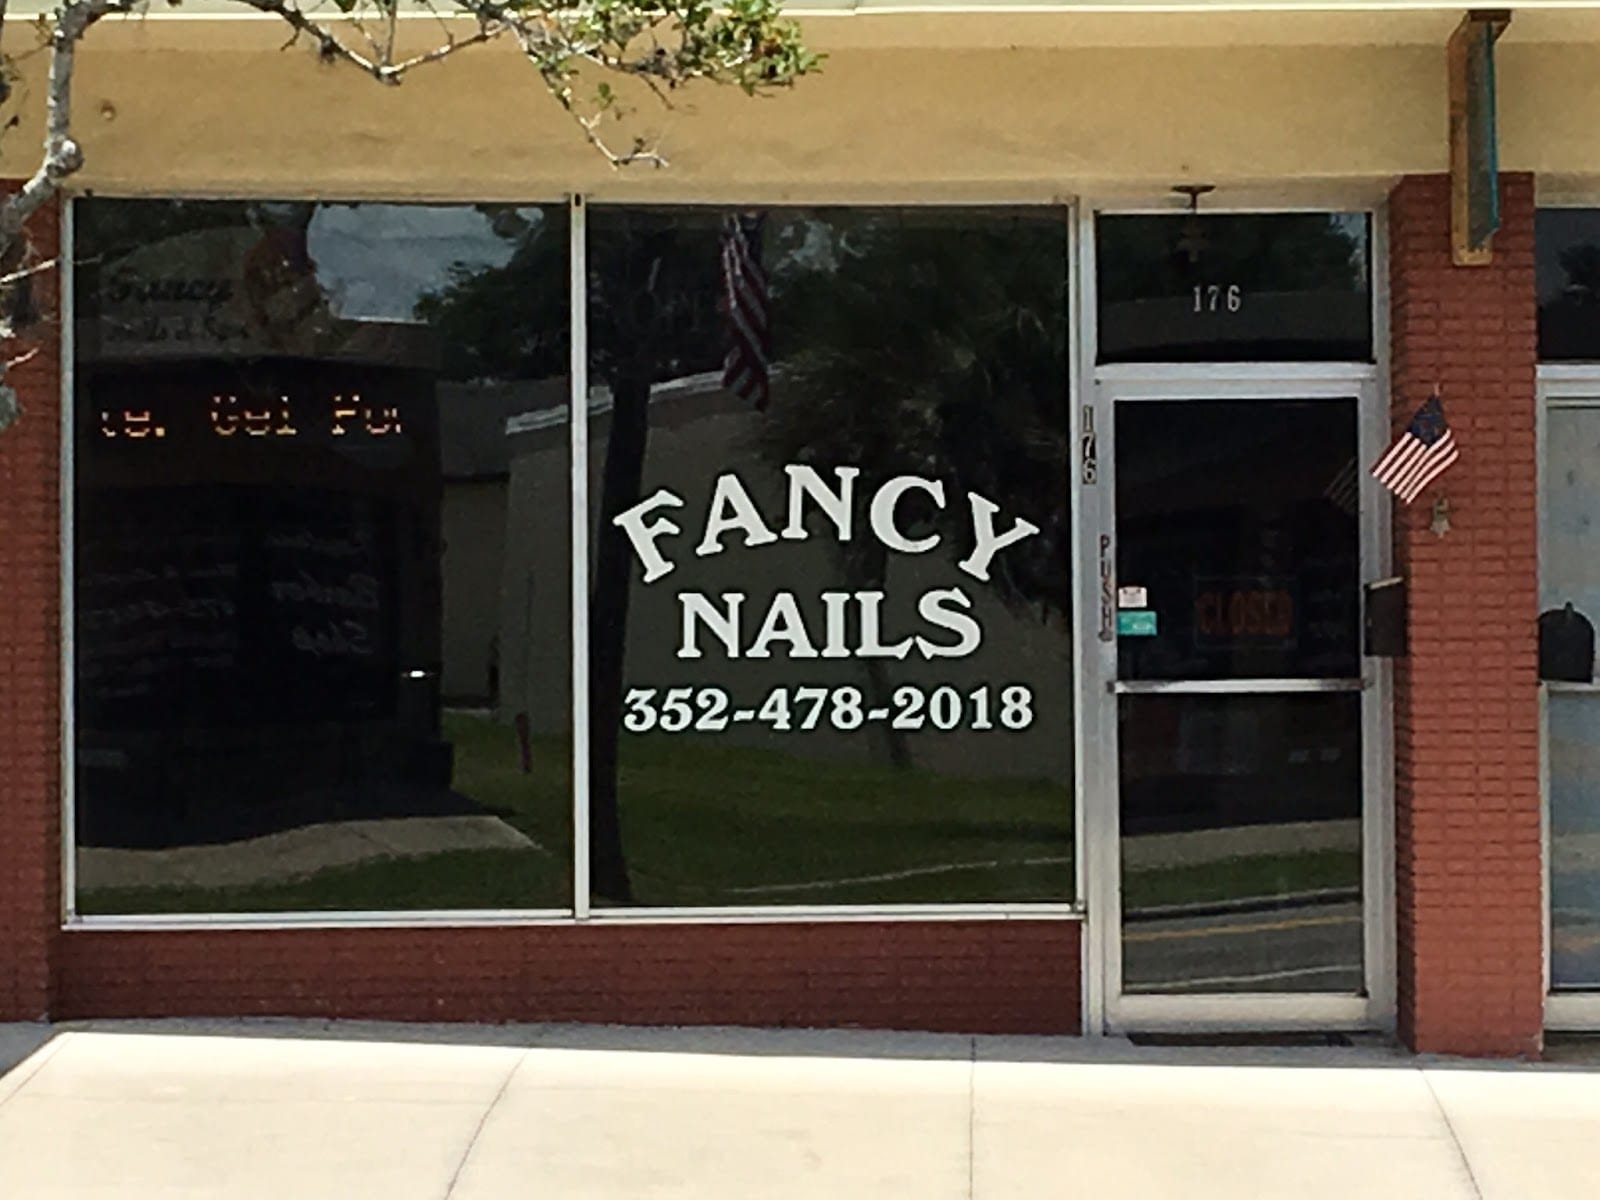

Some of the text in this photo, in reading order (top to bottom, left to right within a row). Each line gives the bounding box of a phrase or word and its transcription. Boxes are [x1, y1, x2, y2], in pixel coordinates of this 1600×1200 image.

[1192, 284, 1242, 312] 176
[1082, 405, 1097, 484] 176
[612, 463, 1041, 584] FANCY
[1099, 533, 1113, 629] PUSH
[1194, 589, 1293, 637] CLOSED
[676, 586, 982, 660] NAILS
[622, 685, 1035, 732] 352-478-2018
